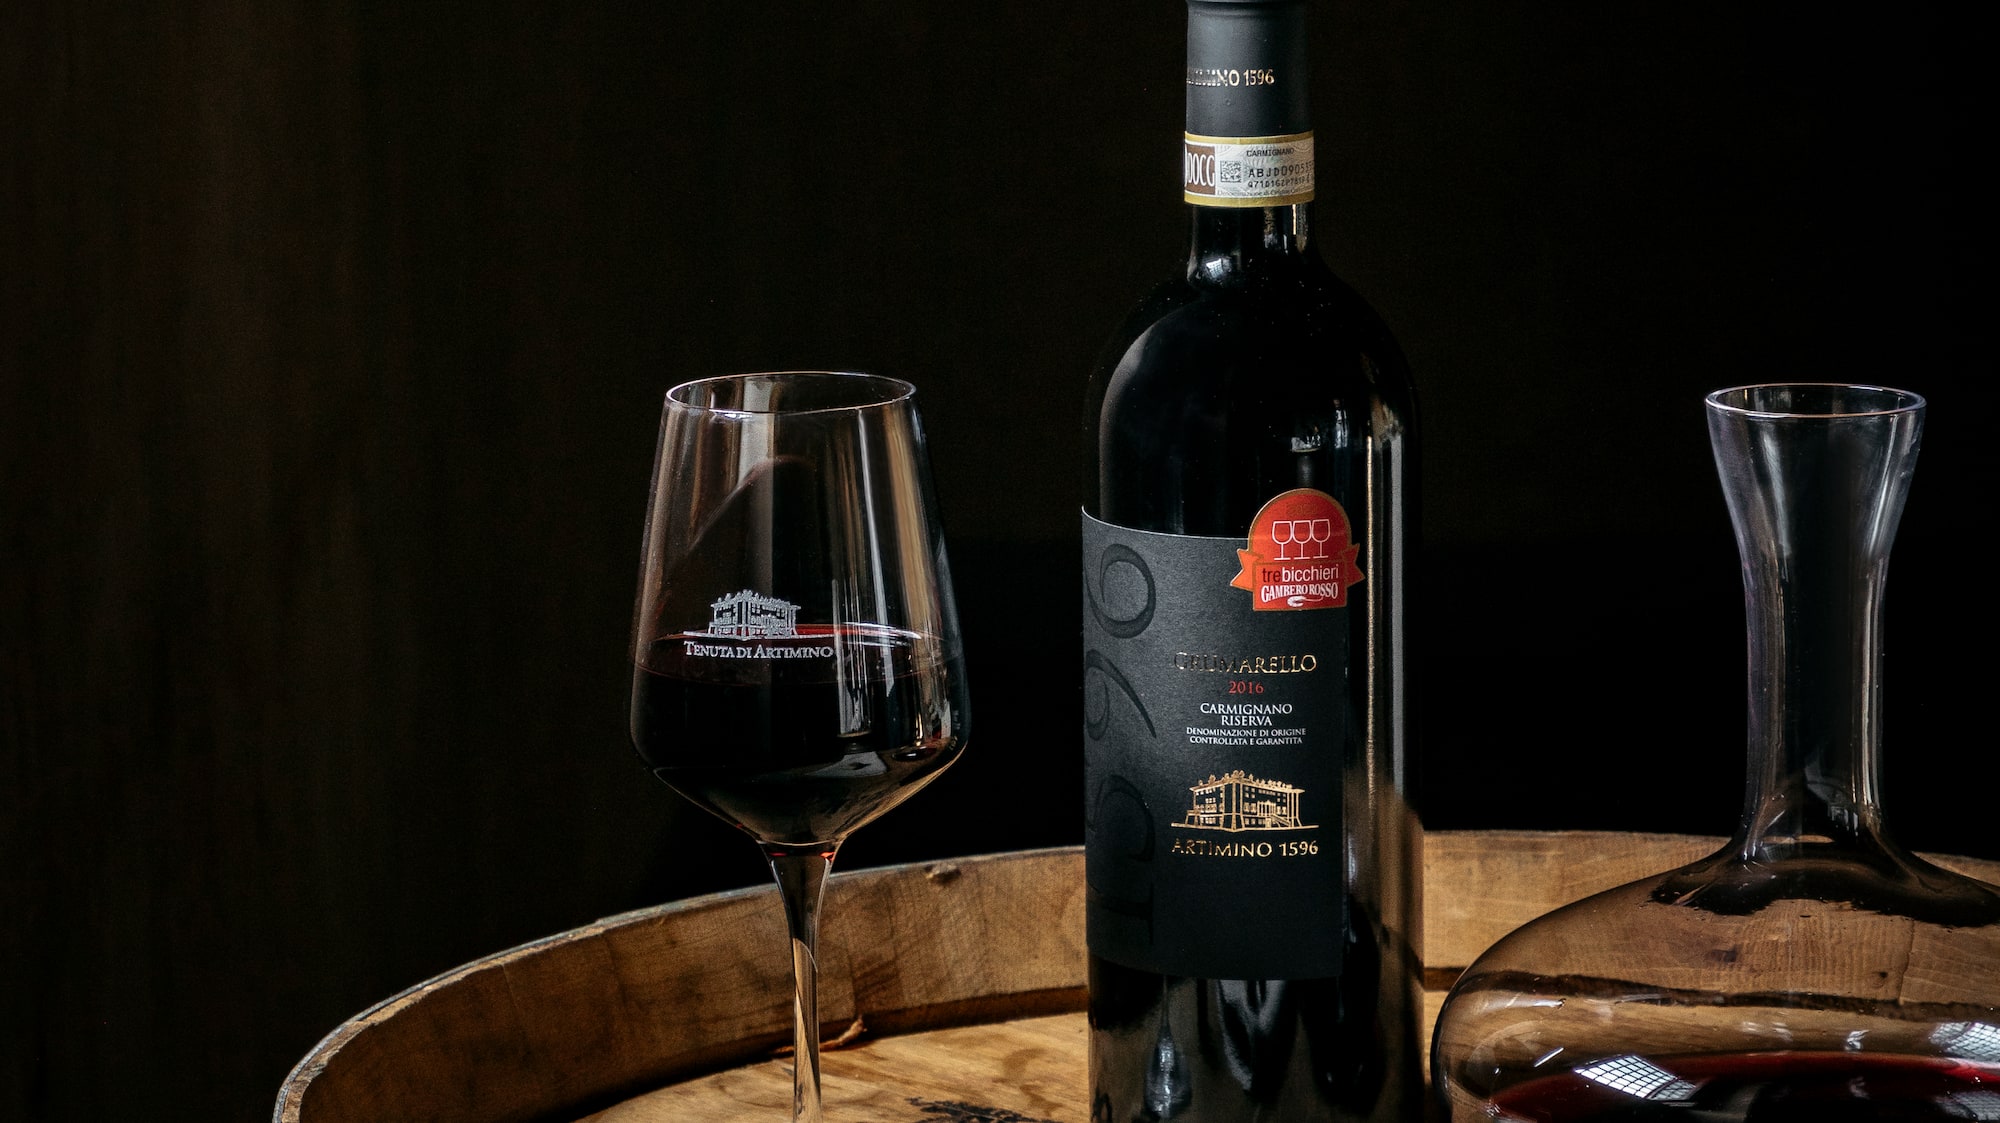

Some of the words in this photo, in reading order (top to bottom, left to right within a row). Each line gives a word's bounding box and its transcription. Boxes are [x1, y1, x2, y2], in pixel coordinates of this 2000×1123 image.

[1243, 69, 1275, 86] 1596
[1246, 148, 1294, 157] CARMIGNANO
[1261, 584, 1308, 603] GAMBERO
[1309, 582, 1339, 599] ROSSO
[683, 640, 736, 658] TENUTA
[736, 647, 752, 659] DI
[753, 644, 834, 659] ARTIMINO
[1174, 651, 1317, 674] GRUMARELLO
[1229, 681, 1264, 694] 2016
[1200, 703, 1293, 715] CARMIGNANO
[1221, 716, 1272, 726] RISERVA
[1186, 727, 1257, 737] DENOMINAZIONE
[1259, 728, 1269, 736] DI
[1271, 728, 1306, 736] ORIGINE
[1190, 736, 1248, 746] CONTROLLATA
[1256, 737, 1303, 746] GARANTITA
[1171, 838, 1273, 857] ARTIMINO
[1278, 839, 1319, 857] 1596
